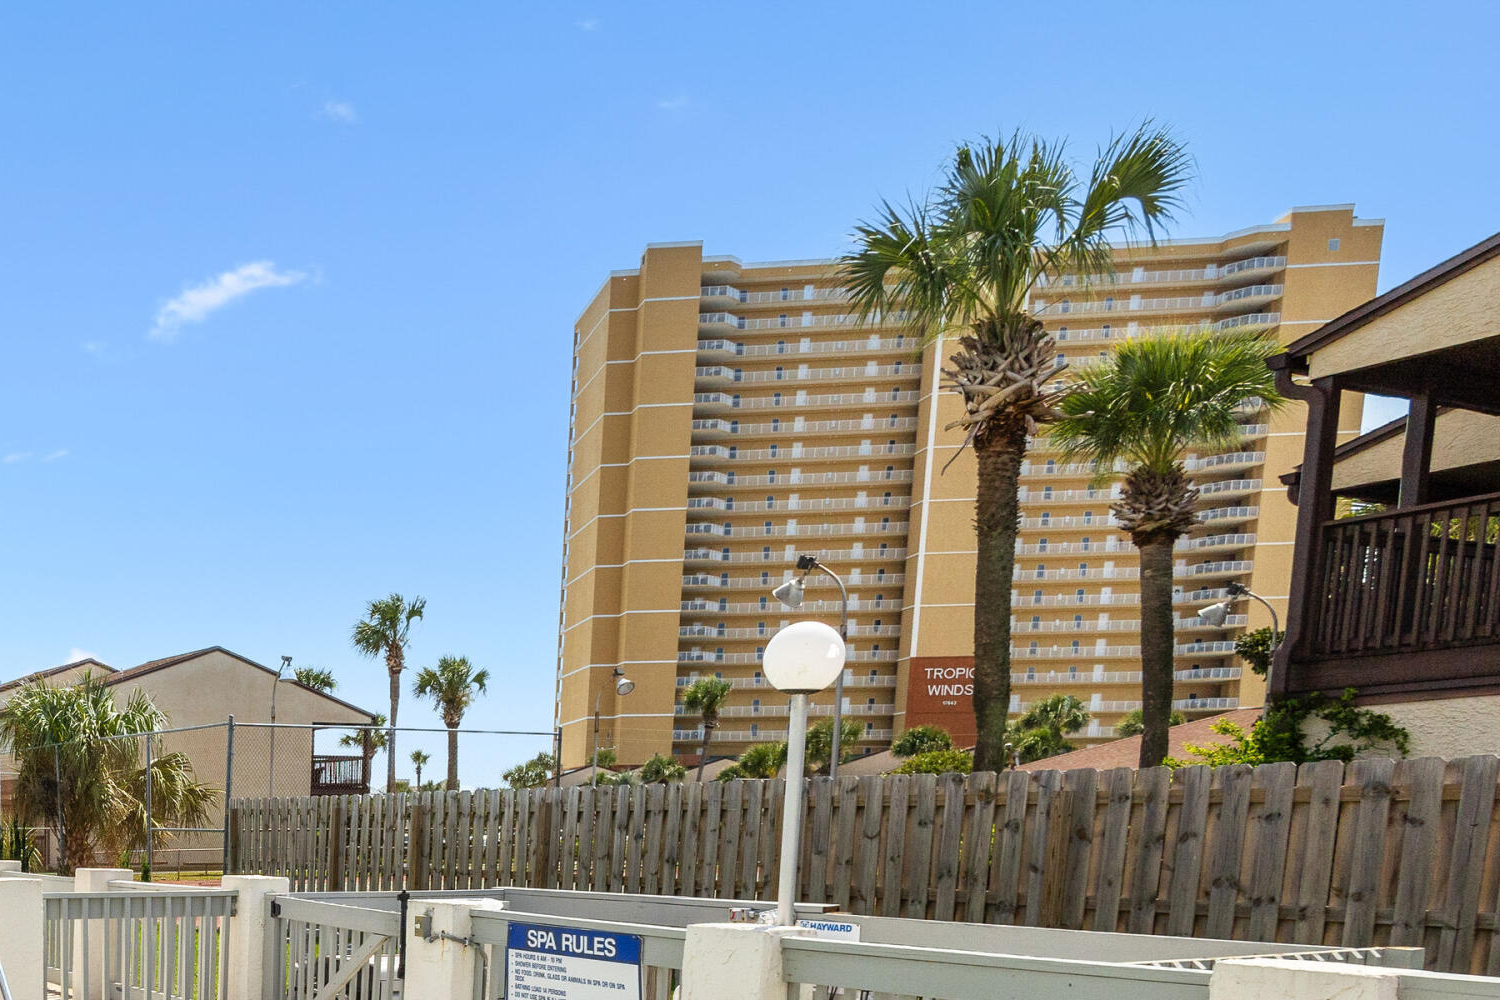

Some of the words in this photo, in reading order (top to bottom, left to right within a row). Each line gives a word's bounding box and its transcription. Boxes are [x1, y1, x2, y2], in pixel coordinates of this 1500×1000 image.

[924, 667, 976, 680] TROPIC
[927, 684, 975, 696] WINDS
[810, 922, 852, 933] HAYWARD
[527, 930, 557, 950] SPA
[562, 934, 617, 957] RULES
[532, 962, 546, 970] BEFORE
[568, 976, 586, 984] ANIMALS
